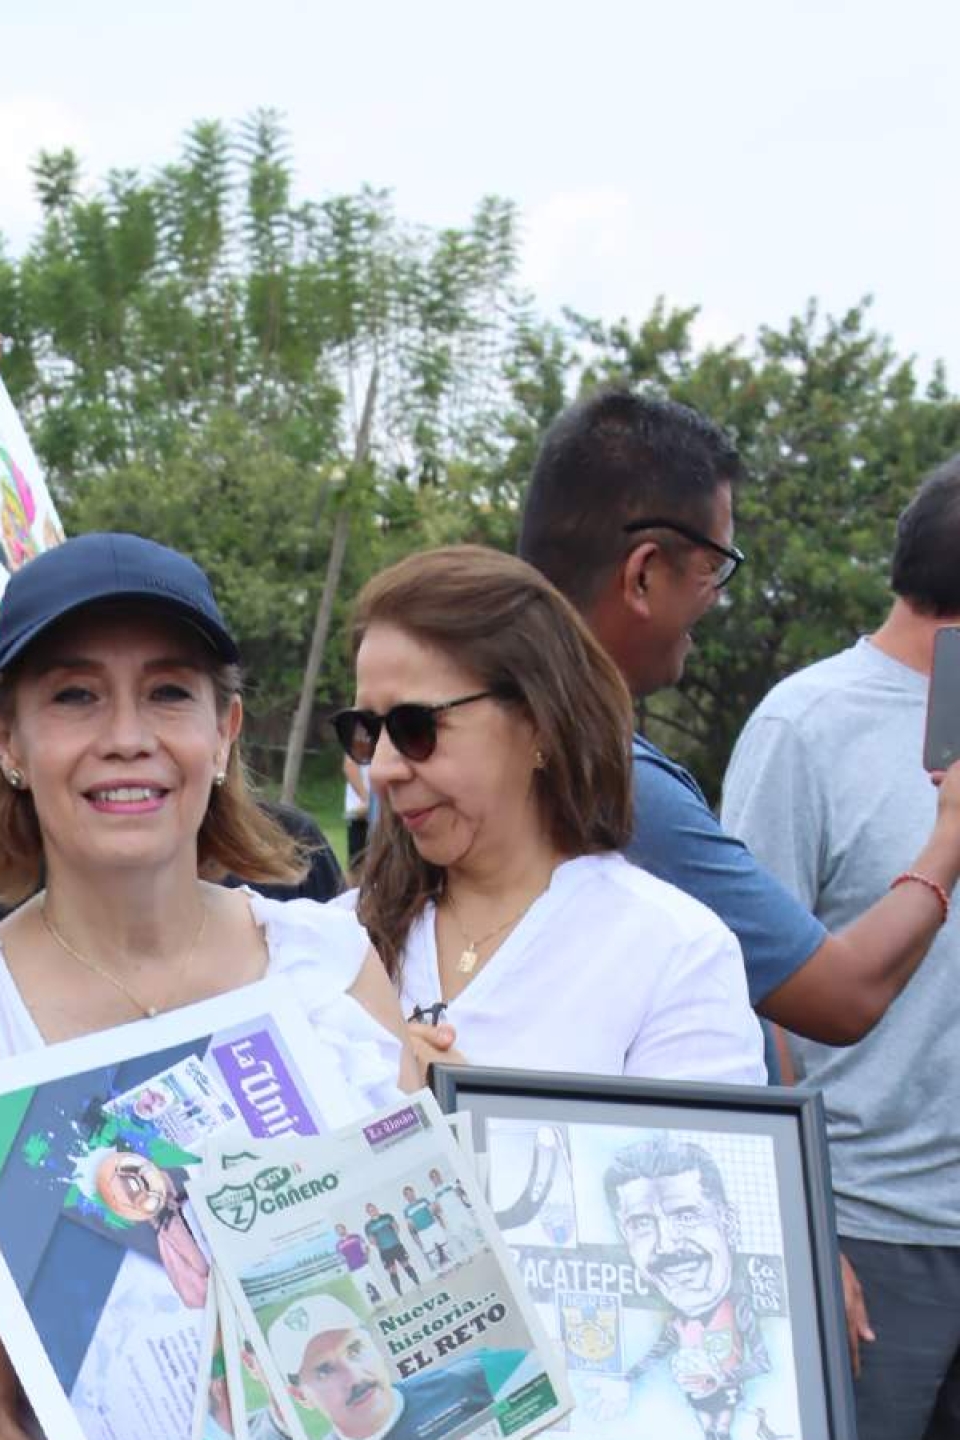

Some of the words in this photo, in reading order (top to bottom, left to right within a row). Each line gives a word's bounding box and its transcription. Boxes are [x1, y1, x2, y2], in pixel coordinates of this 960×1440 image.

[379, 1292, 450, 1336] Nueva
[387, 1292, 496, 1355] historia...
[396, 1350, 433, 1379] EL
[434, 1303, 506, 1357] RETO
